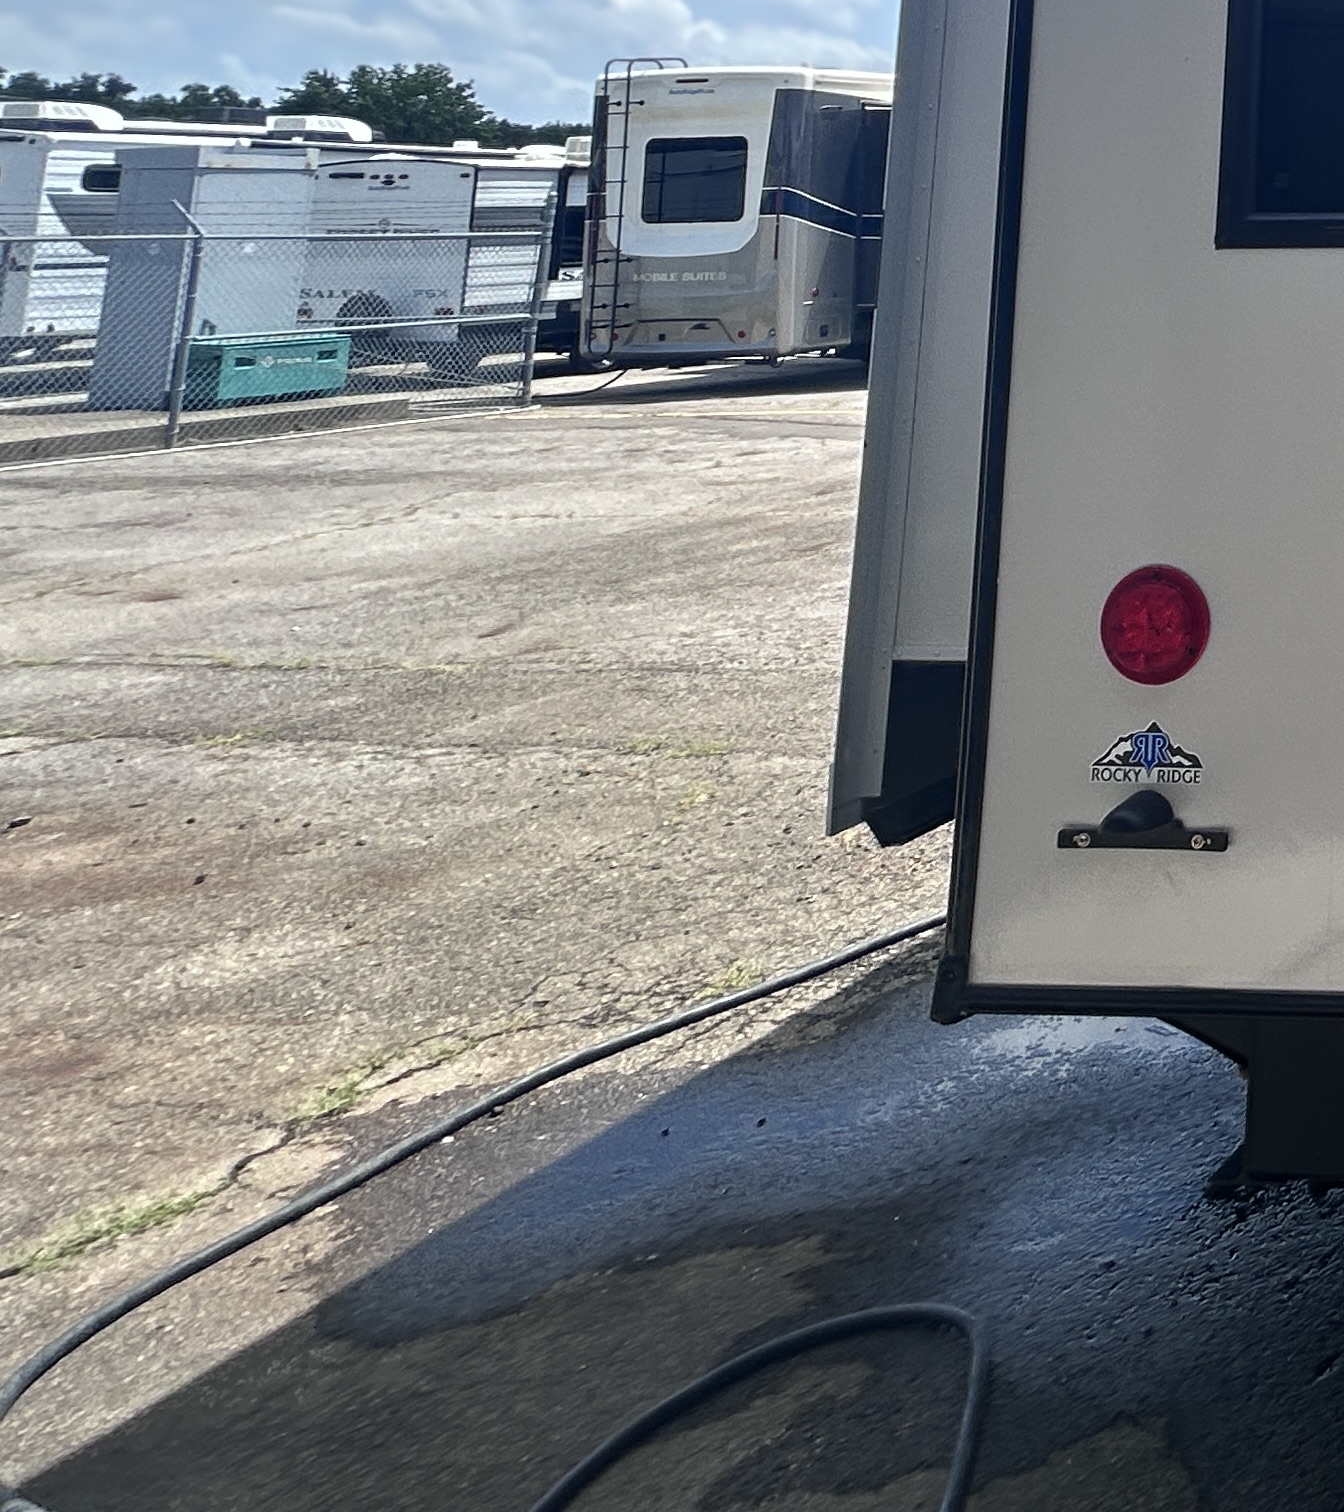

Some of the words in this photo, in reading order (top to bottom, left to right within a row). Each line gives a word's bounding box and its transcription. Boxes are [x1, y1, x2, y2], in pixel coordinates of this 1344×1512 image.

[632, 272, 677, 282] MOBILE
[681, 271, 727, 282] SUITES
[1091, 767, 1141, 782] ROCKY
[1157, 769, 1201, 784] RIDGE
